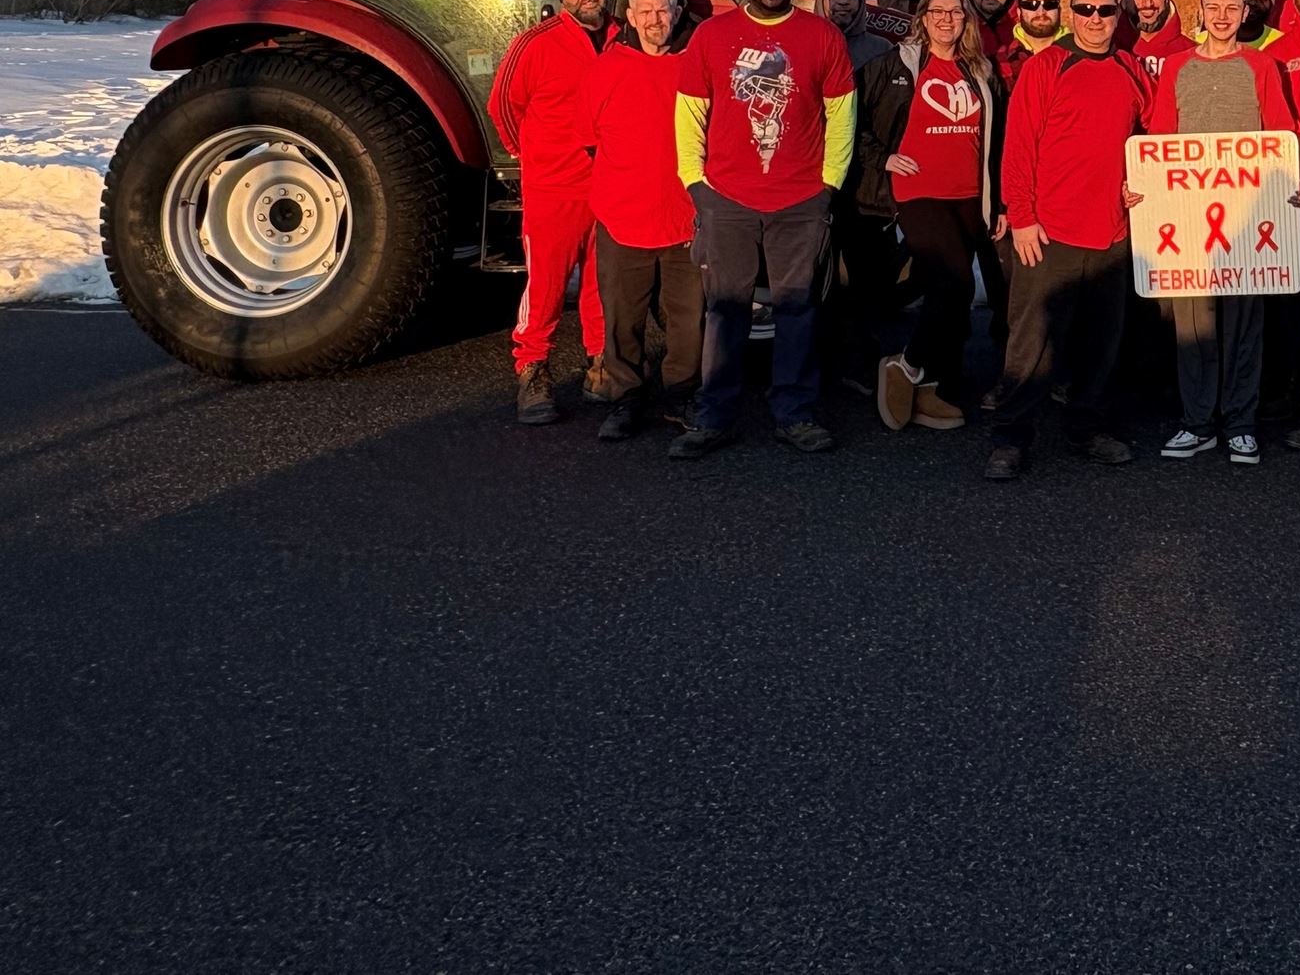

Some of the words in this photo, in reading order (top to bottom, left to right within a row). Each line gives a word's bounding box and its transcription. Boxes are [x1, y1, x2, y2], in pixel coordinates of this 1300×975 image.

[1140, 140, 1204, 163] RED
[1217, 137, 1282, 160] FOR
[1167, 167, 1260, 191] RYAN
[1149, 268, 1243, 291] FEBRUARY
[1250, 266, 1290, 288] 11TH
